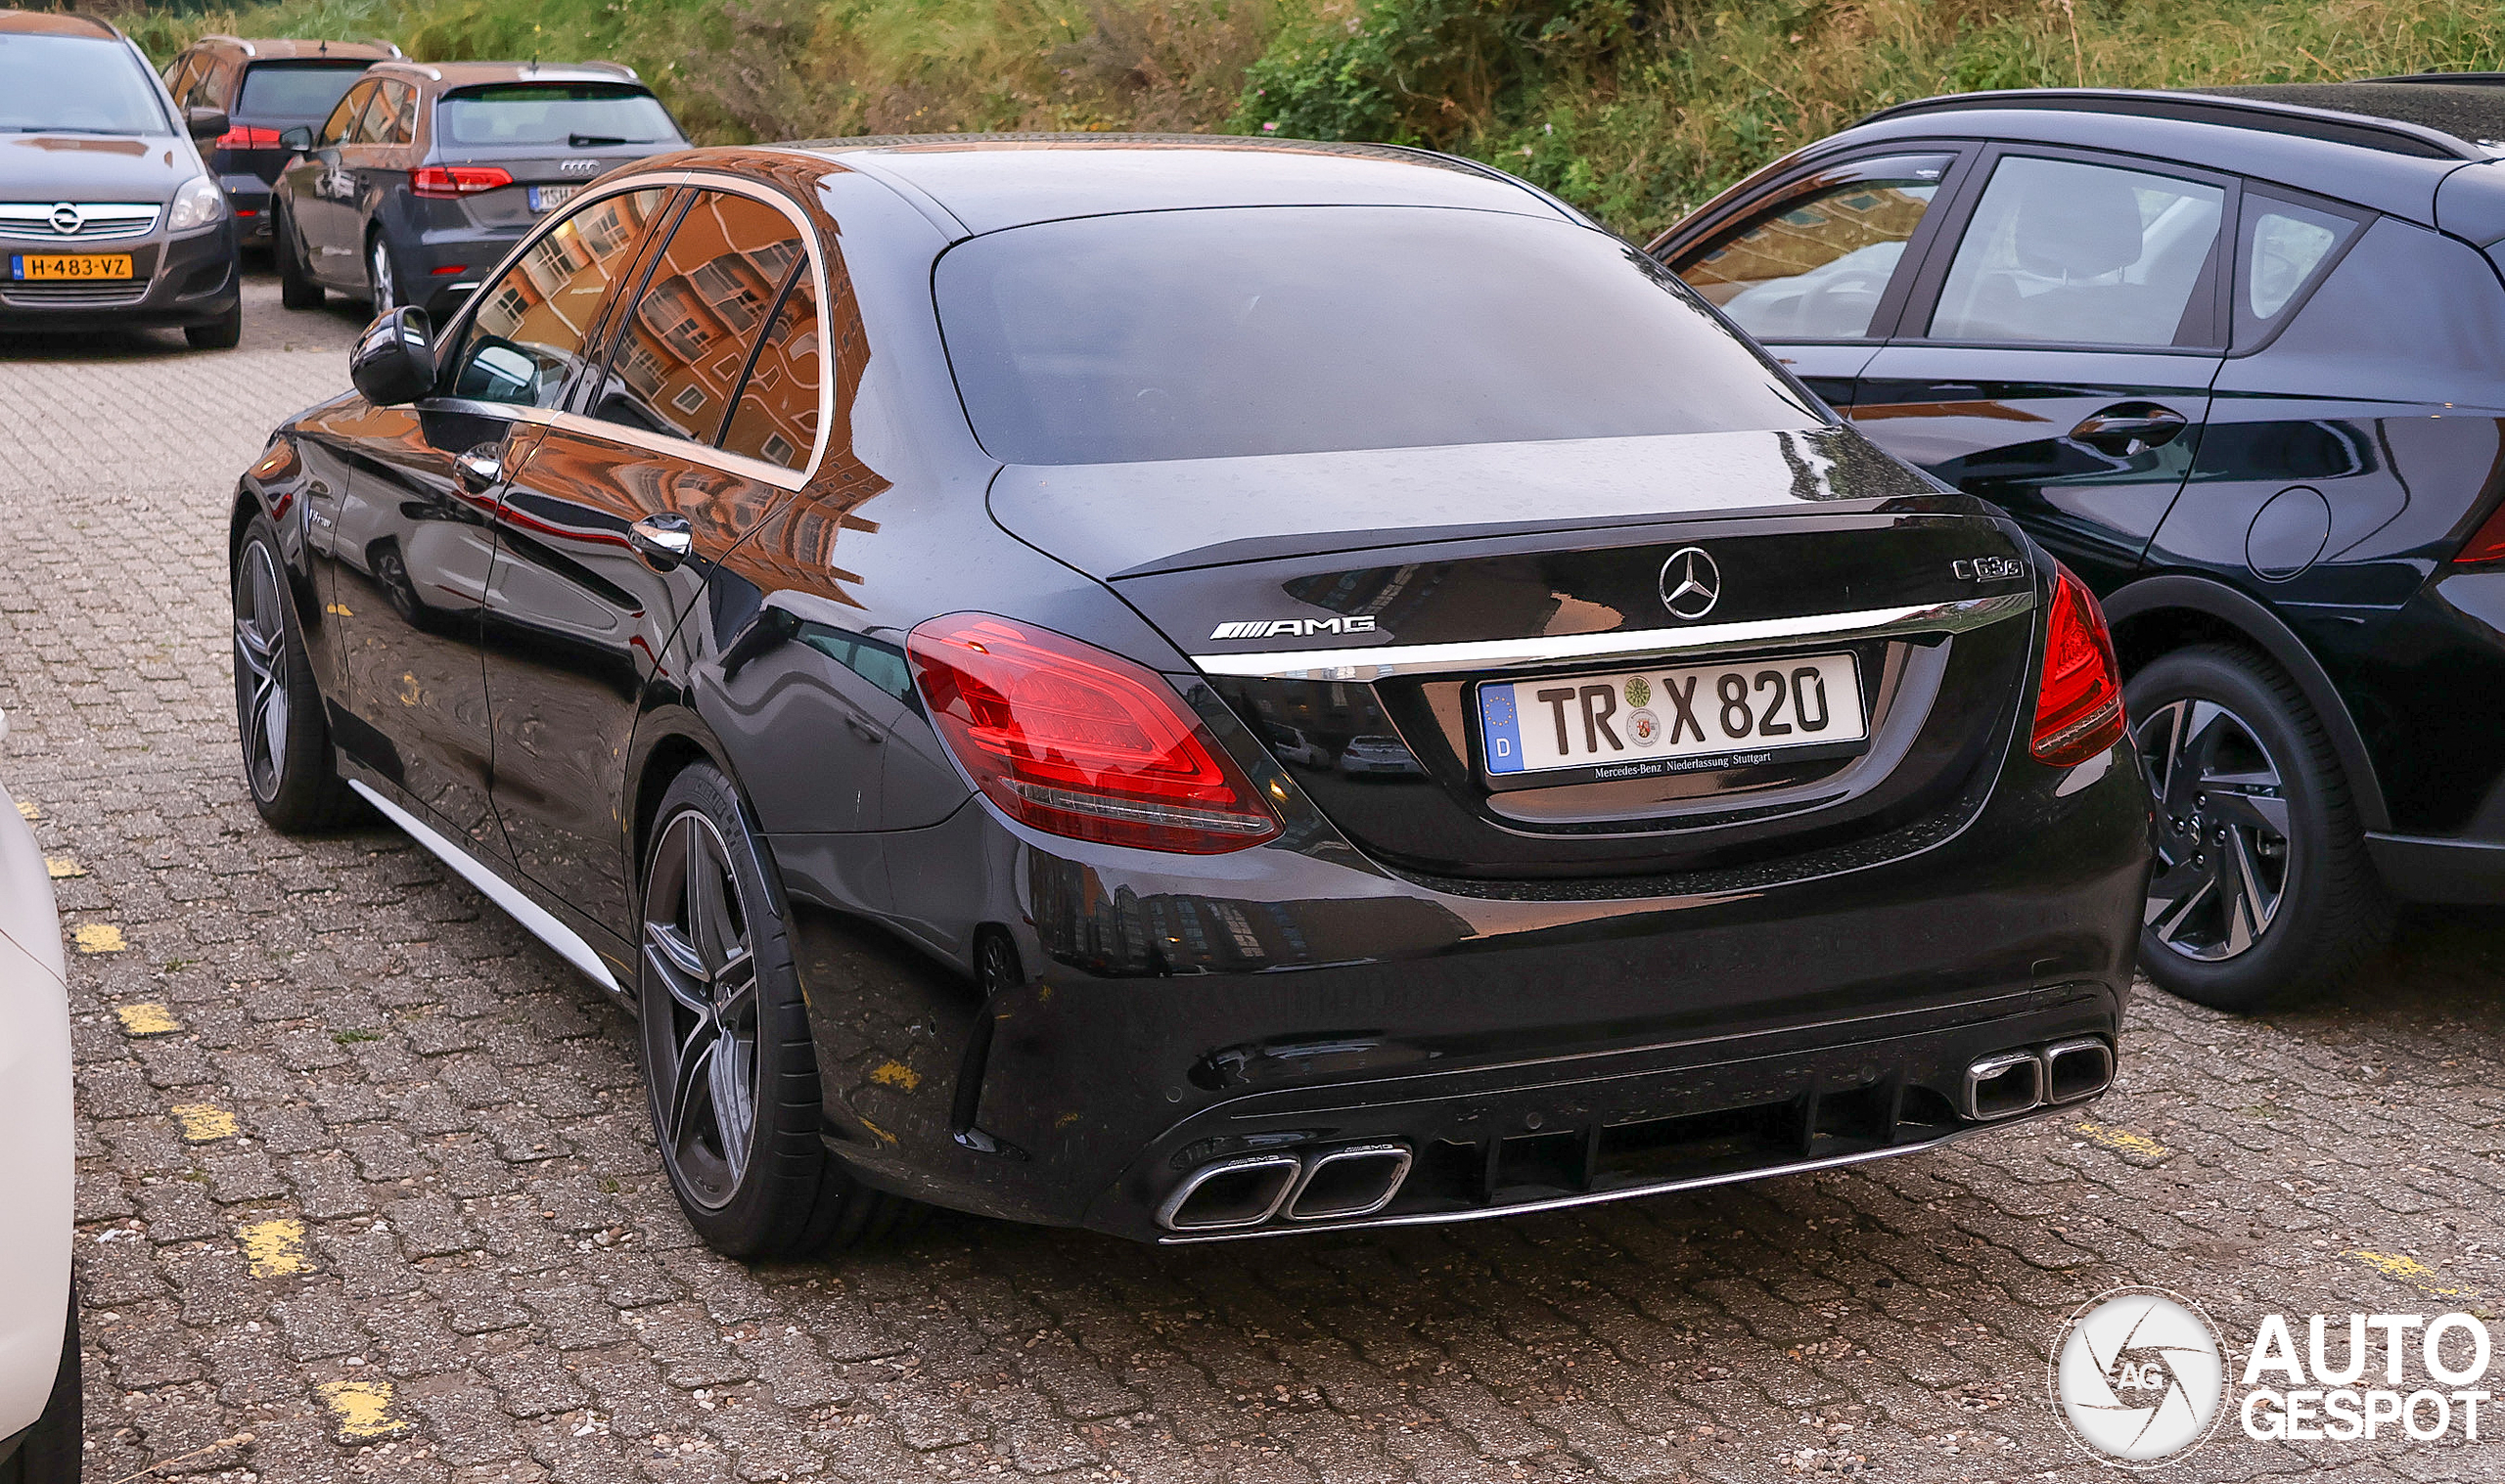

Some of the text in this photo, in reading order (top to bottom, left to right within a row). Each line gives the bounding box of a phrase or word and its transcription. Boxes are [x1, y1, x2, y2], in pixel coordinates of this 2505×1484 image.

[31, 258, 126, 276] H-483-VZ
[1263, 615, 1376, 637] AMG
[1536, 684, 1625, 756] TR
[1662, 676, 1707, 745] X
[1716, 666, 1830, 740] 820
[1495, 737, 1512, 758] D
[1594, 751, 1772, 780] Mercedes-Benz Niederlassung Stuttgart
